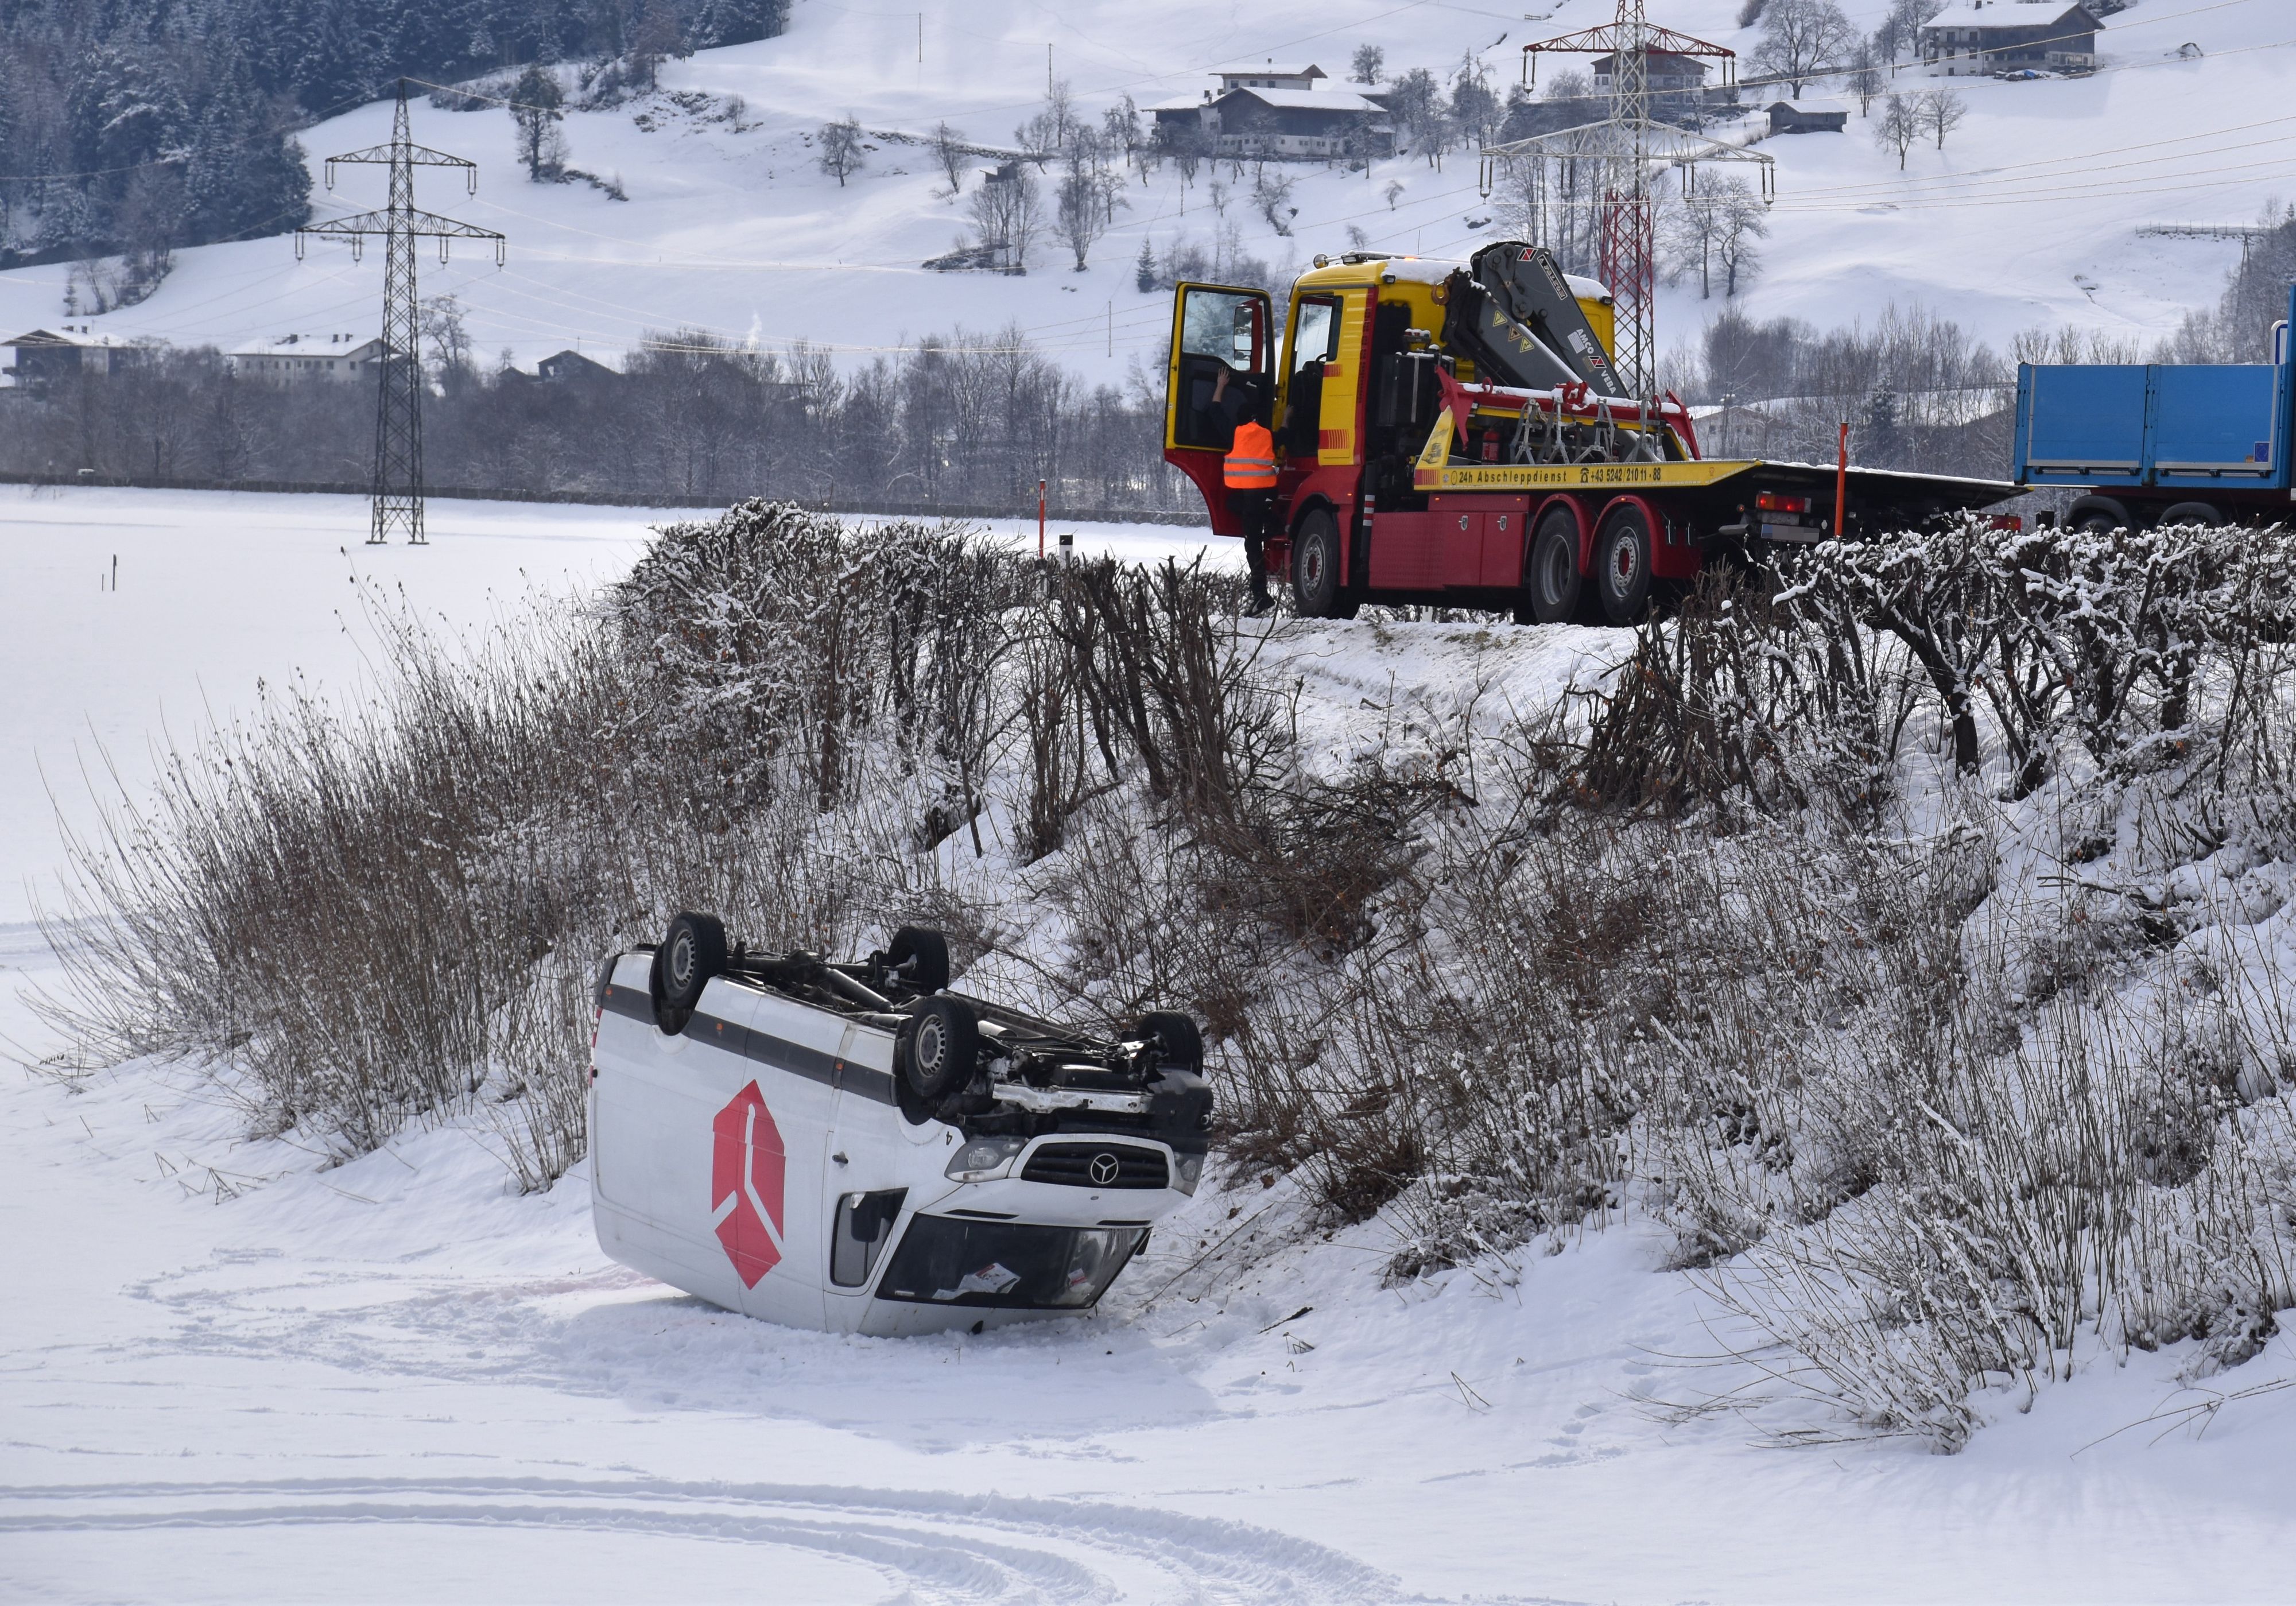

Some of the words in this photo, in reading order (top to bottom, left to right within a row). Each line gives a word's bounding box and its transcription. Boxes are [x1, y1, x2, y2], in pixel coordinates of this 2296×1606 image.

[1576, 328, 1595, 354] AMCO
[1601, 369, 1616, 395] VEBA
[1459, 471, 1472, 483] 24h
[1477, 470, 1566, 484] Abschleppdienst
[1591, 468, 1603, 482] +43
[1653, 467, 1661, 481] 88
[946, 1131, 953, 1146] 4
